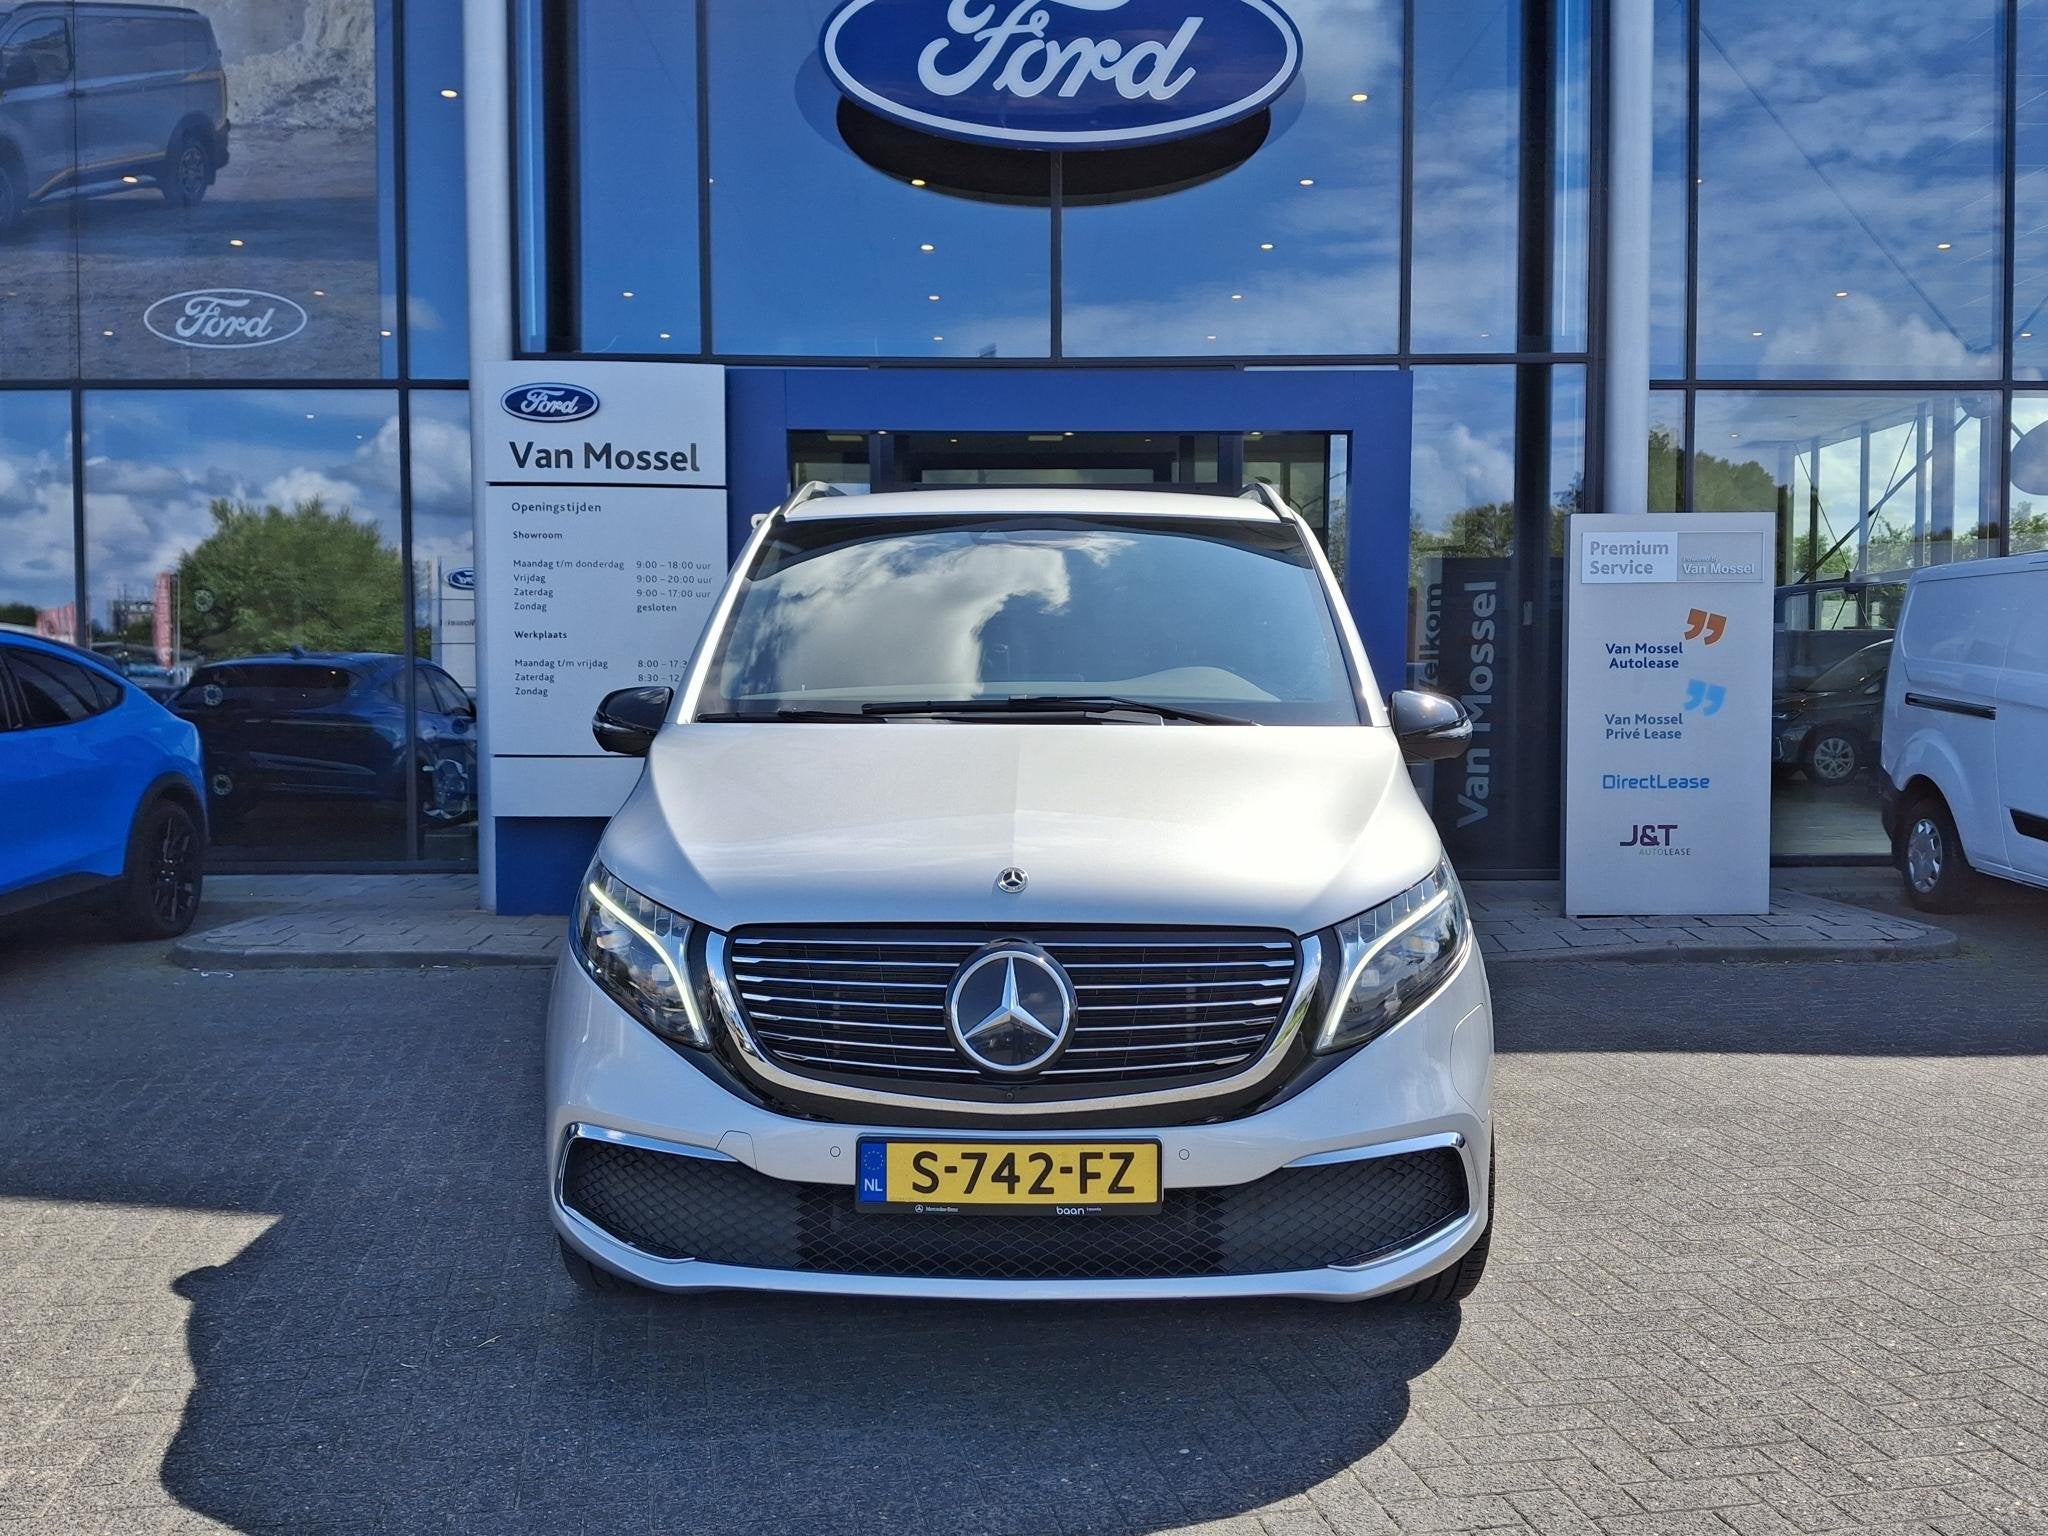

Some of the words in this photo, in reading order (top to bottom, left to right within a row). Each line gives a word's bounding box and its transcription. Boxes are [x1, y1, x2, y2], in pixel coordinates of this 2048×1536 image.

[918, 0, 1204, 100] Ford
[175, 296, 276, 339] Ford
[520, 388, 580, 415] Ford
[509, 441, 574, 469] Van
[584, 442, 700, 472] Mossel
[511, 501, 602, 515] Openingstijden
[512, 530, 563, 540] Showroom
[1590, 540, 1669, 556] Premium
[513, 559, 554, 570] Maandag
[556, 560, 573, 569] t/m
[575, 560, 625, 571] donderdag
[636, 561, 658, 569] 9:00
[667, 561, 694, 570] 18:00
[1589, 560, 1654, 575] Service
[1682, 562, 1707, 574] Van
[1710, 562, 1755, 574] Mossel
[513, 573, 546, 585] Vrijdag
[636, 575, 658, 584] 9:00
[667, 575, 695, 584] 20:00
[513, 588, 554, 599] Zaterdag
[636, 589, 658, 598] 9:00
[668, 589, 693, 598] 17:00
[513, 602, 547, 613] Zondag
[636, 602, 677, 613] gesloten
[514, 630, 568, 641] Werkplaats
[1605, 643, 1631, 654] Van
[1635, 642, 1683, 655] Mossel
[1463, 581, 1496, 732] Mossel
[514, 659, 555, 669] Maandag
[557, 659, 575, 668] t/m
[577, 659, 609, 670] vrijdag
[638, 660, 659, 668] 8:00
[1609, 657, 1680, 669] Autolease
[515, 673, 555, 684] Zaterdag
[638, 673, 659, 682] 8:30
[515, 687, 548, 698] Zondag
[1605, 714, 1631, 725] Van
[1635, 713, 1683, 725] Mossel
[1606, 728, 1641, 740] Privé
[1644, 728, 1682, 740] Lease
[1602, 774, 1710, 790] DirectLease
[1457, 749, 1490, 828] Van
[1619, 824, 1678, 847] J&T
[1638, 848, 1691, 856] AUTOLEASE
[912, 1150, 1136, 1195] S-742-FZ
[864, 1178, 883, 1192] NL
[1056, 1205, 1085, 1216] baan
